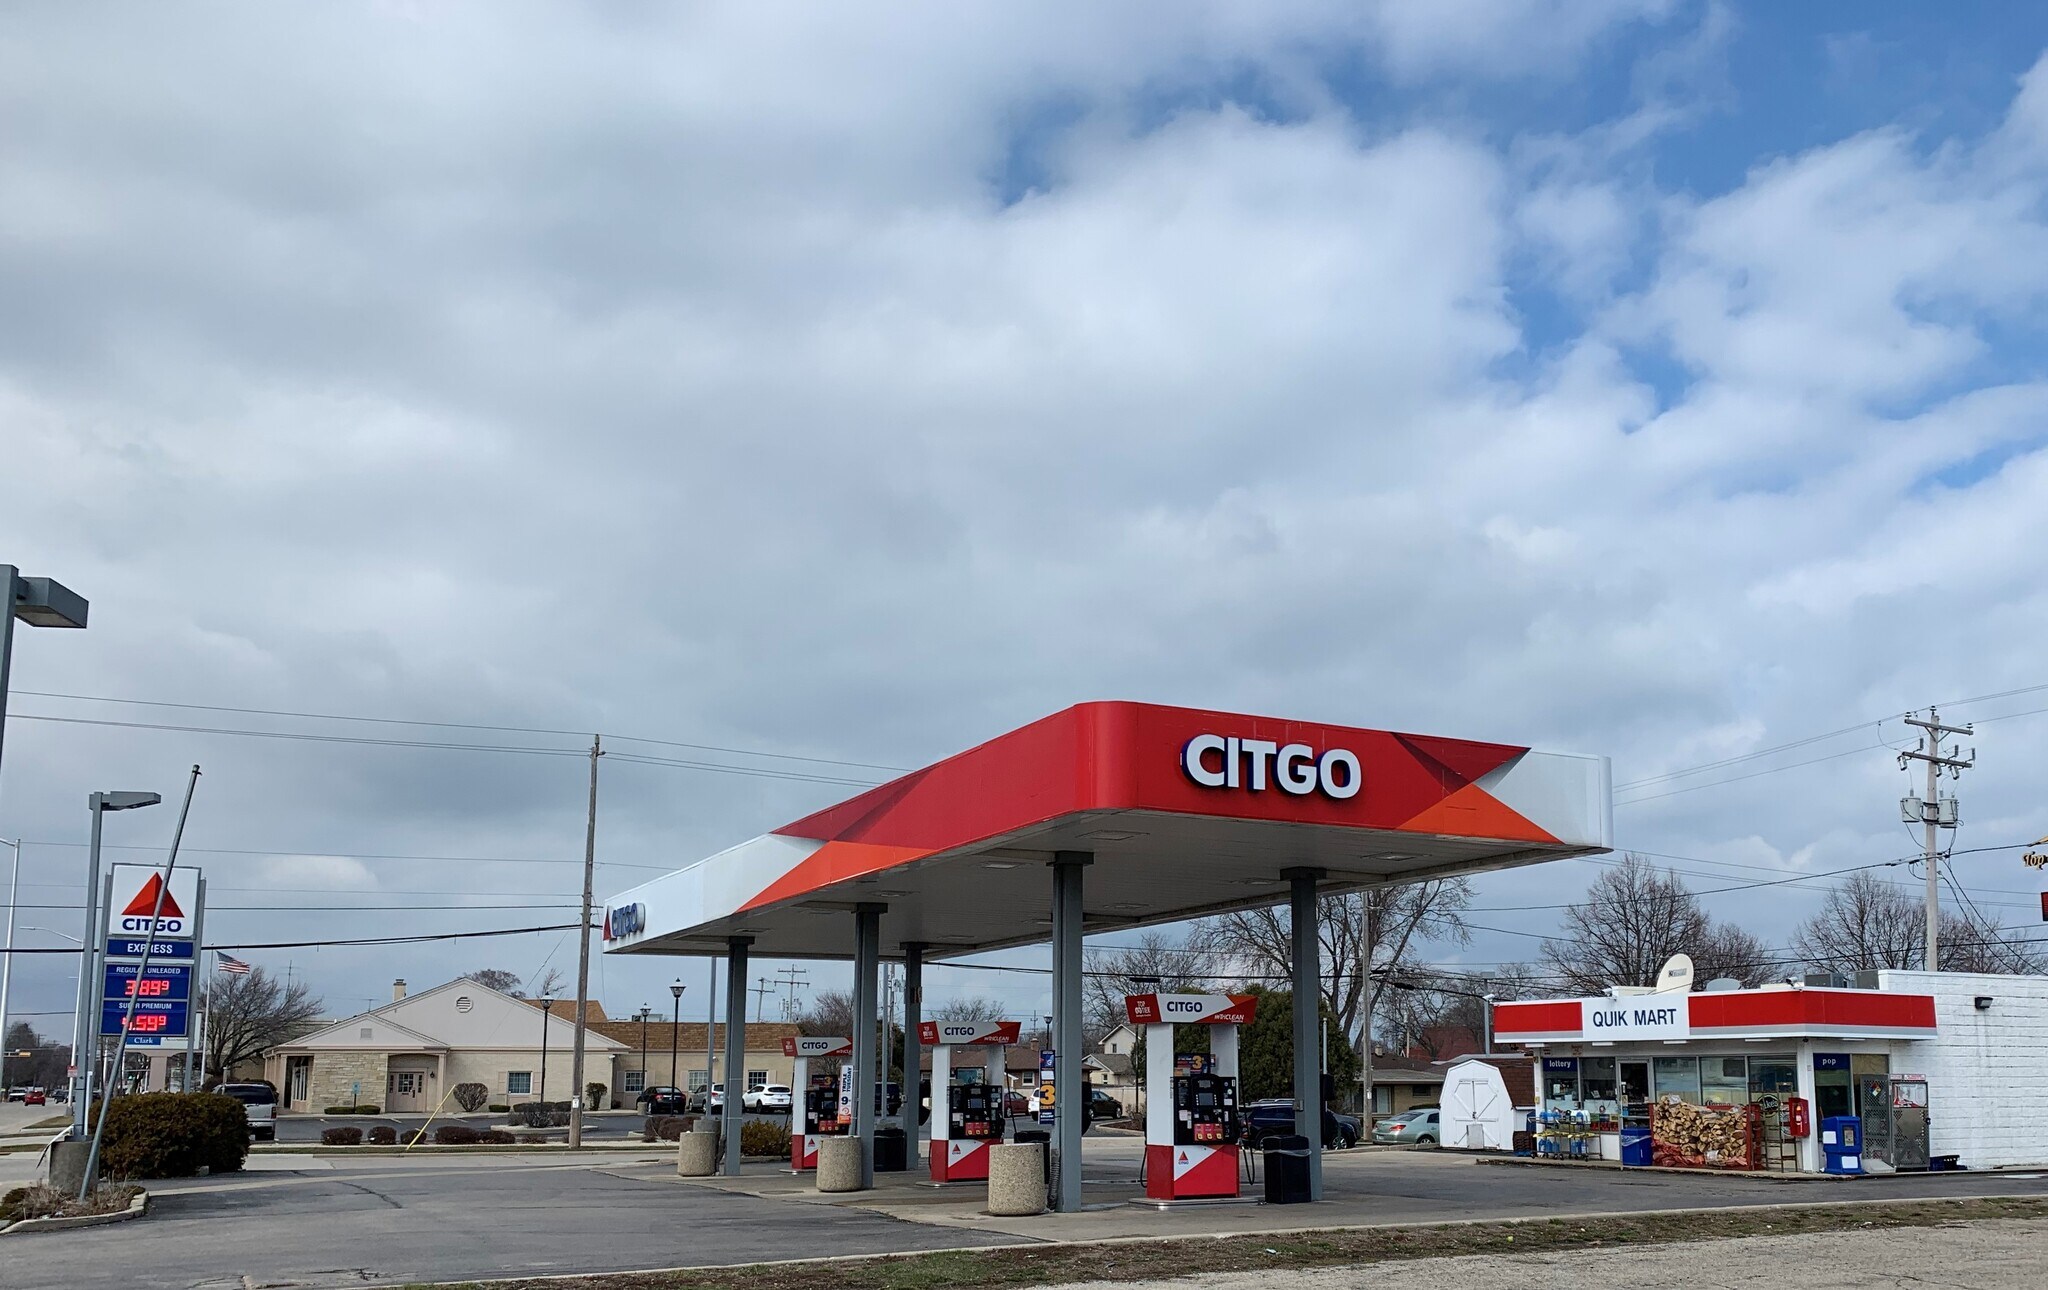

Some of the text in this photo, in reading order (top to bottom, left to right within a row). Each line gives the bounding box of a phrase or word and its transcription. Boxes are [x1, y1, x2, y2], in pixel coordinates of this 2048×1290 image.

[1184, 733, 1362, 799] CITGO
[121, 918, 182, 932] CITGO
[116, 966, 181, 974] REGULA UNLEADED
[1166, 1001, 1203, 1012] CITGO
[1592, 1009, 1677, 1027] QUIK MART
[944, 1026, 975, 1036] CITGO
[133, 1036, 154, 1044] Clark
[801, 1041, 828, 1050] CITGO
[1192, 1055, 1203, 1069] 3
[1549, 1060, 1571, 1069] lottery
[1822, 1058, 1837, 1066] pop
[1040, 1084, 1055, 1105] 3
